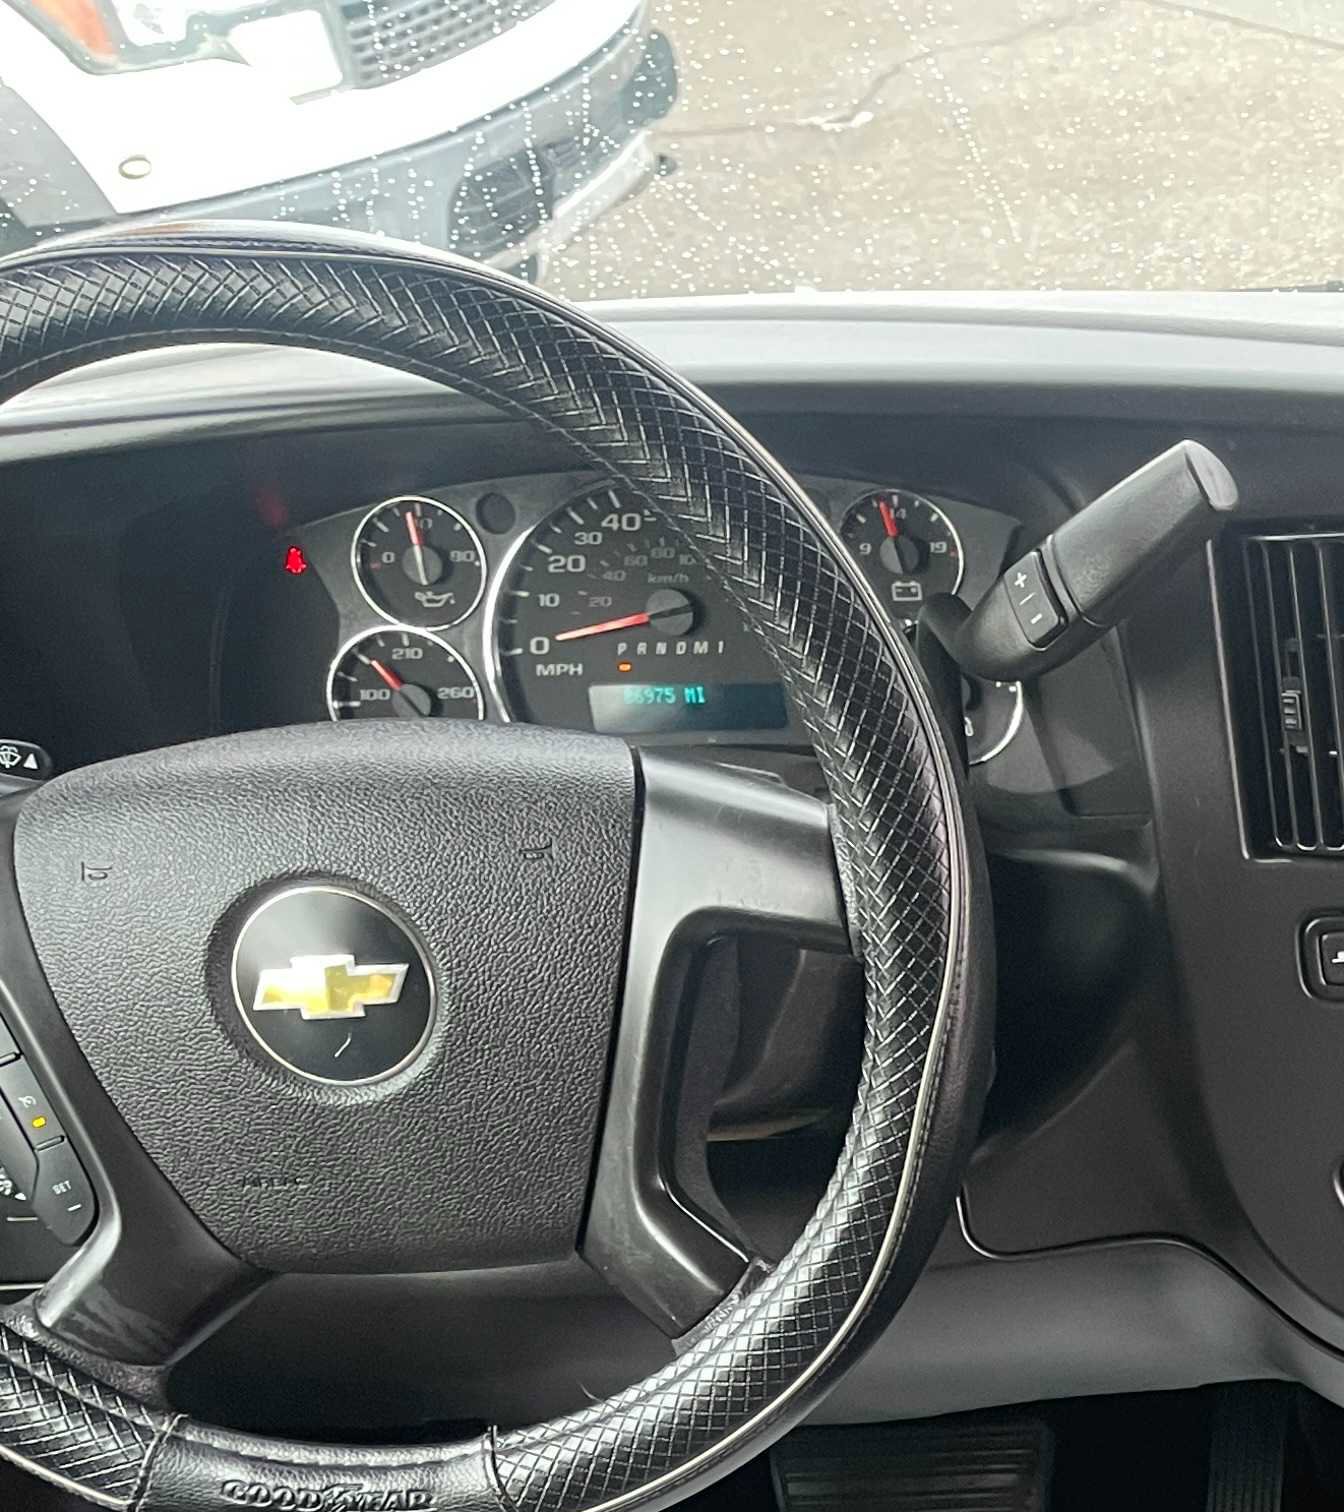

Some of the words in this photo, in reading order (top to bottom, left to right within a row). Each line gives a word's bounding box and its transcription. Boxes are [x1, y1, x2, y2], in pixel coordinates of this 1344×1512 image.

[601, 513, 641, 531] 40
[574, 532, 603, 545] 30
[860, 543, 871, 555] 9
[929, 542, 947, 553] 19
[383, 552, 395, 563] 0
[548, 555, 586, 573] 20
[538, 594, 560, 608] 10
[588, 597, 612, 608] 20
[530, 636, 550, 655] 0
[392, 648, 423, 660] 210
[536, 664, 583, 676] MPH
[360, 689, 391, 700] 100
[438, 687, 475, 699] 260
[684, 687, 705, 704] MI
